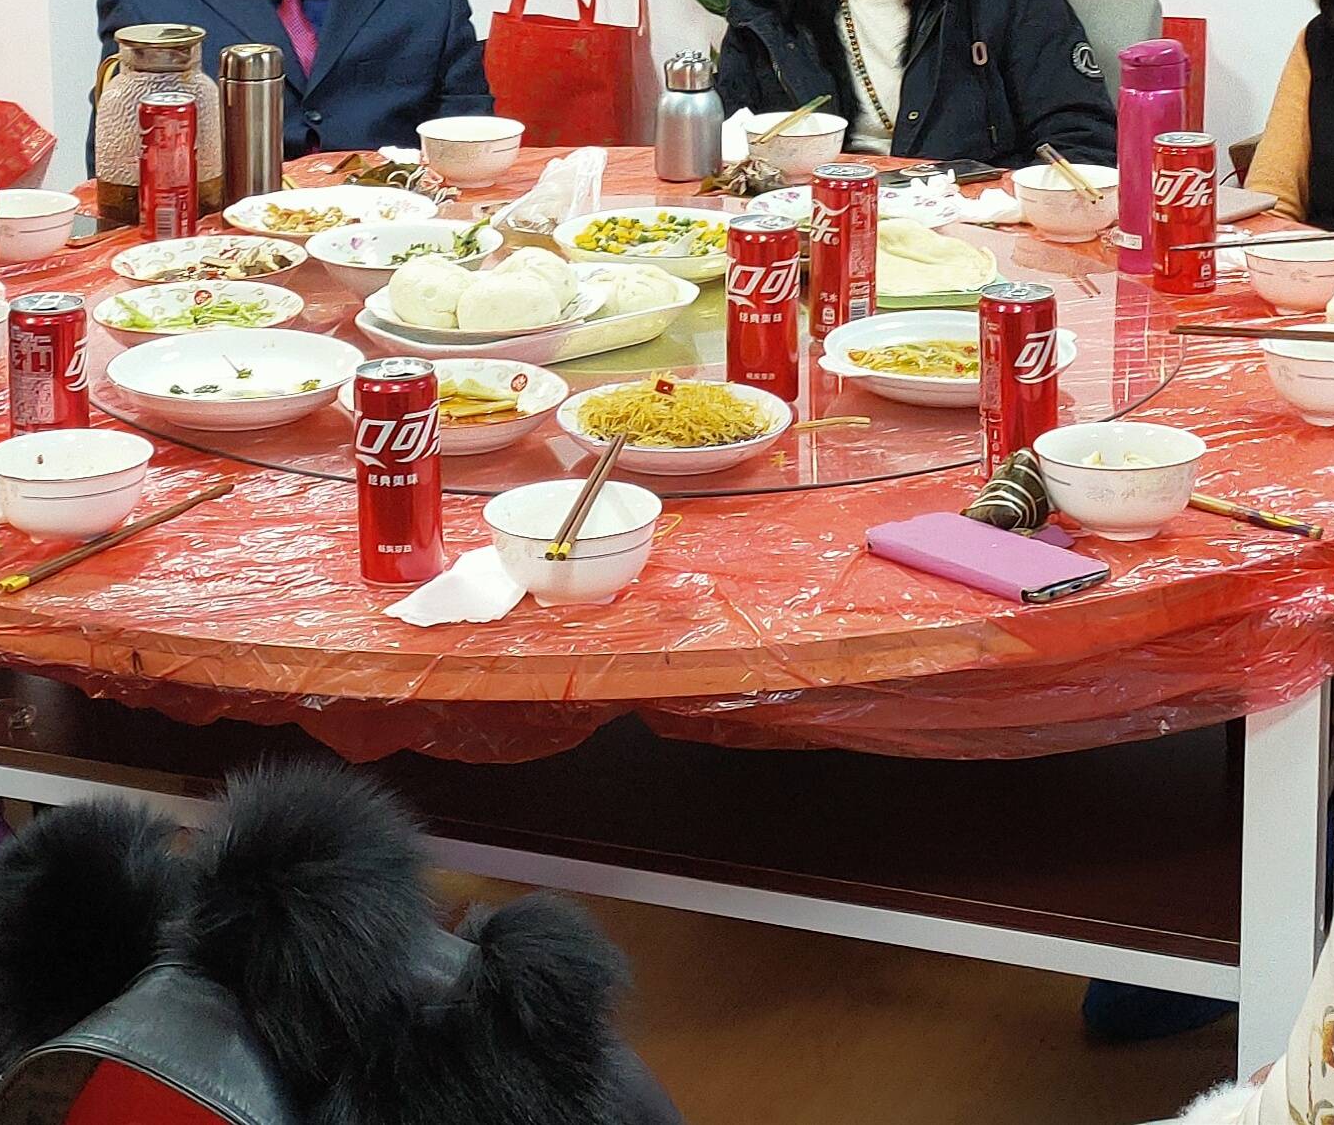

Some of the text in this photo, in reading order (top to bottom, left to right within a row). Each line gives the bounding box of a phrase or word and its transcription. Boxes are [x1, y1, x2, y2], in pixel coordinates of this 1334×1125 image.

[1152, 168, 1216, 208] 可乐
[1014, 330, 1058, 379] 可
[355, 405, 440, 463] 口可
